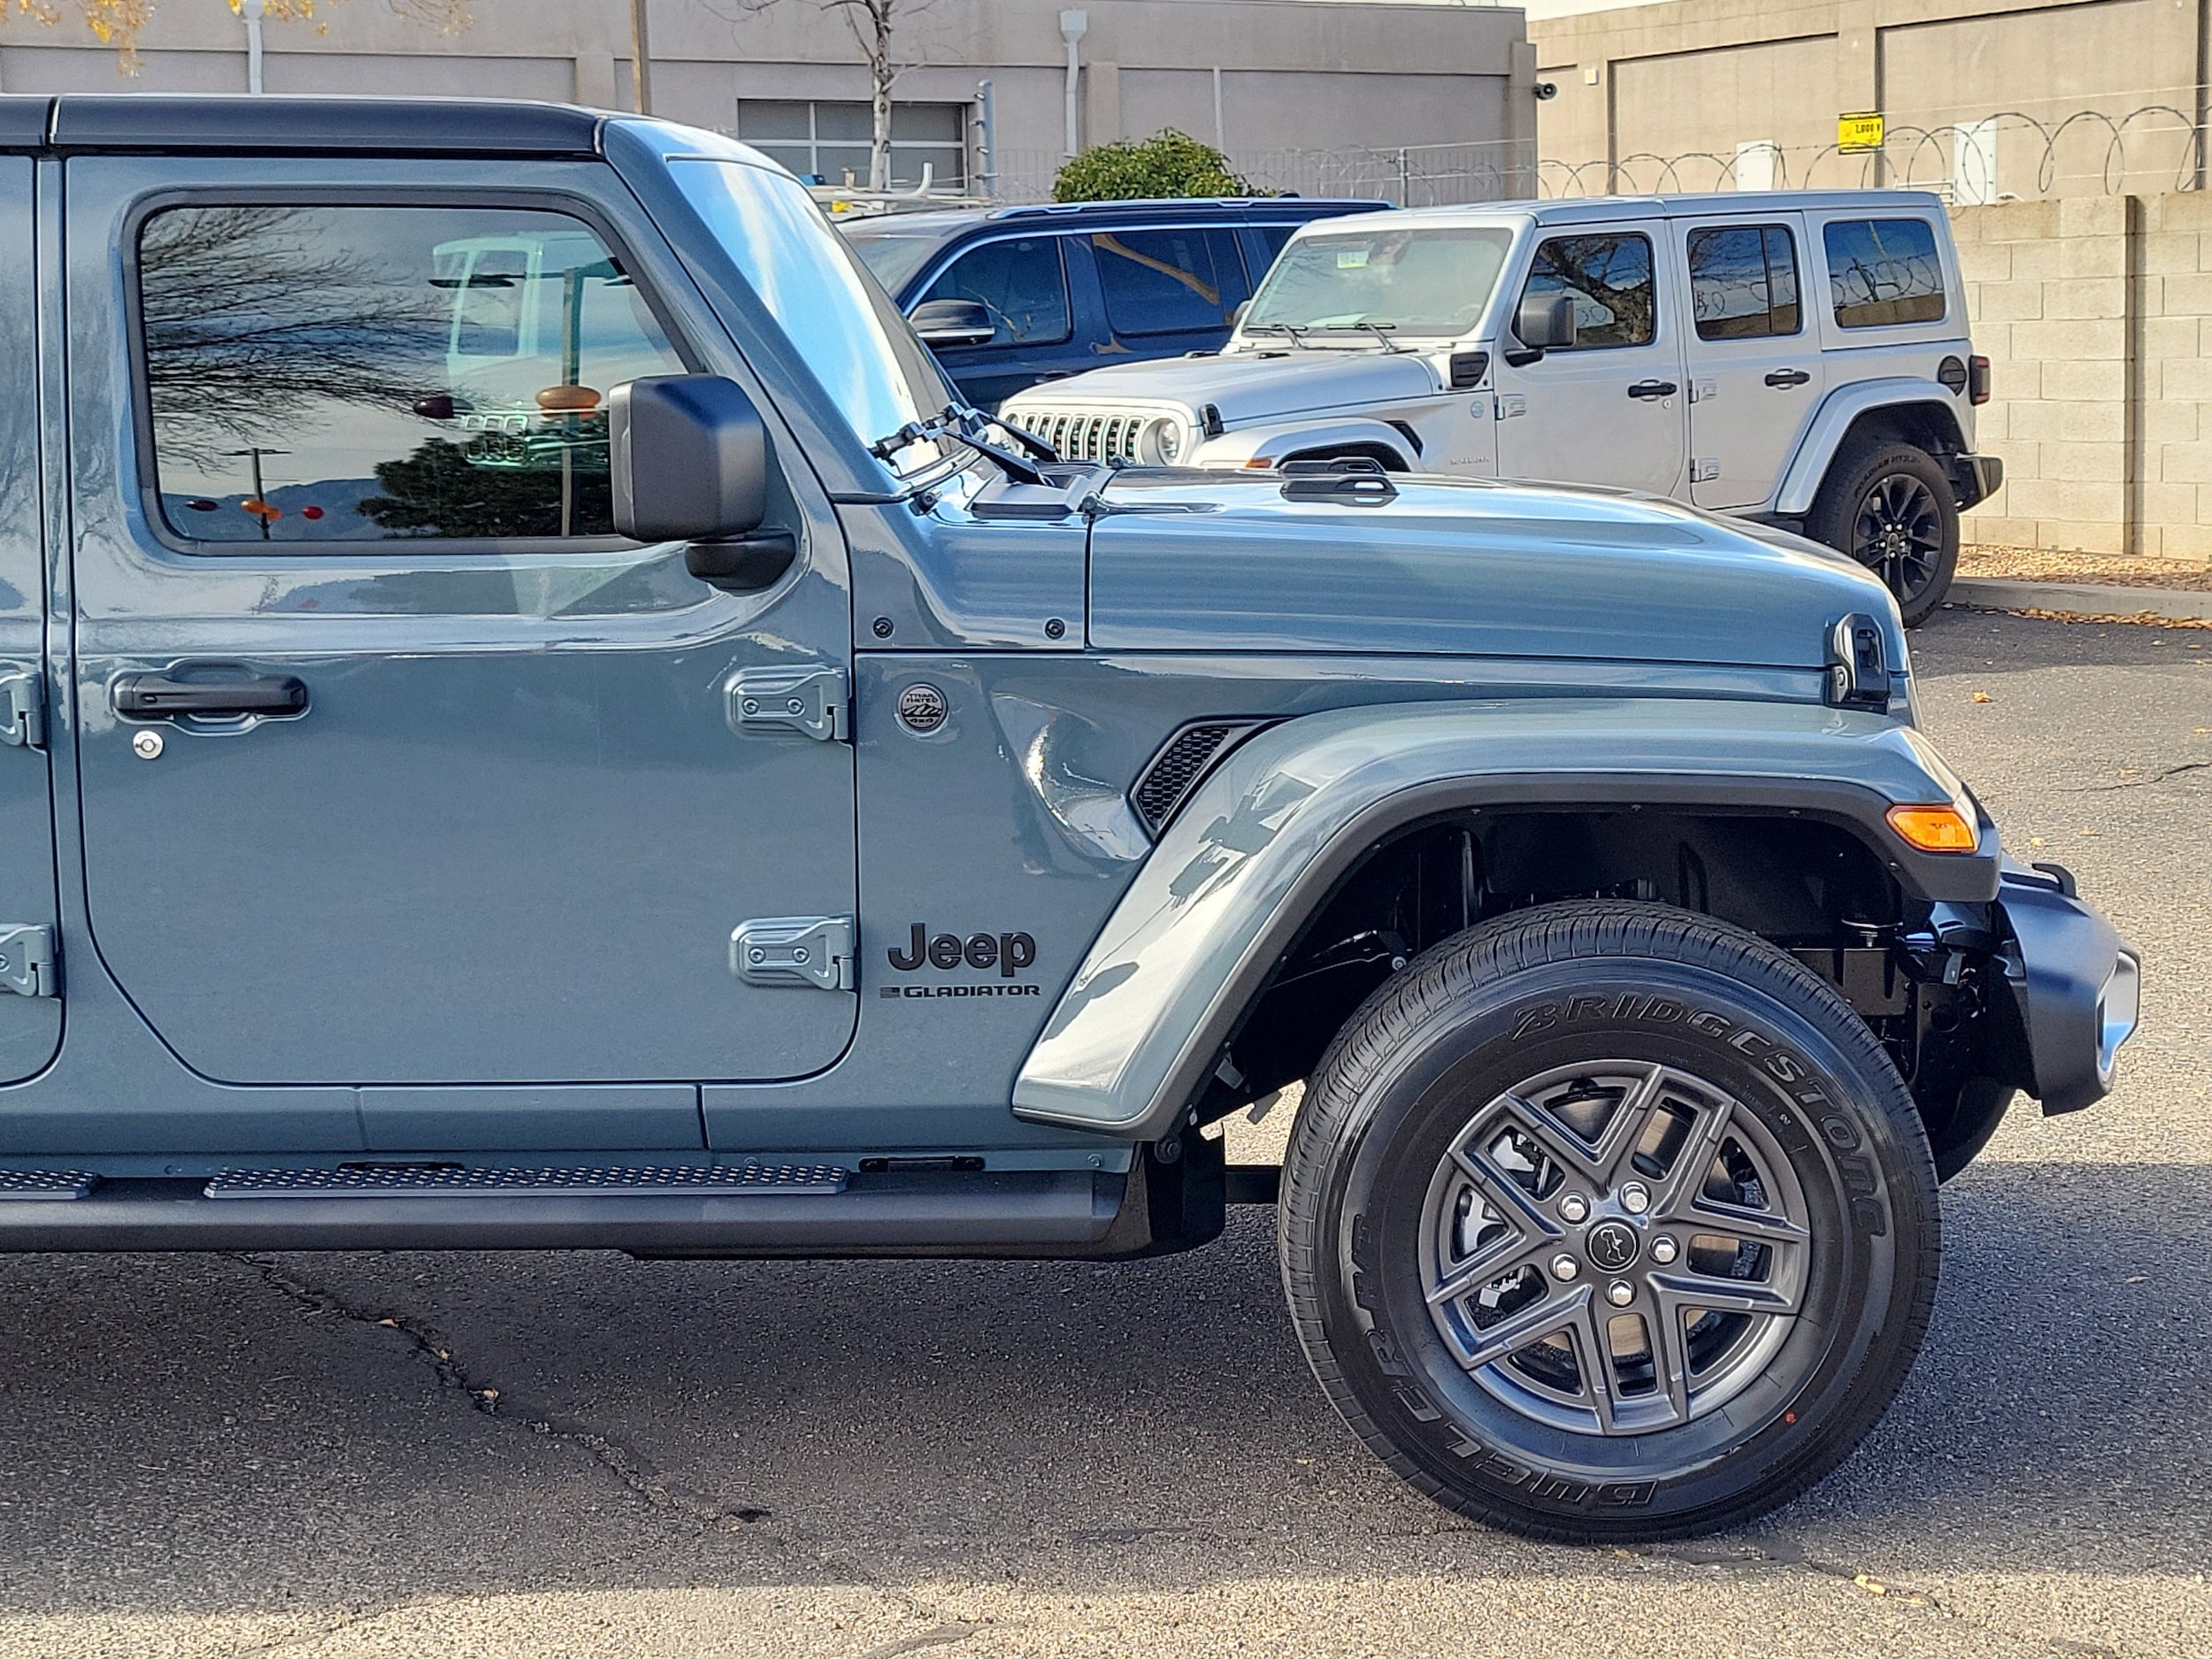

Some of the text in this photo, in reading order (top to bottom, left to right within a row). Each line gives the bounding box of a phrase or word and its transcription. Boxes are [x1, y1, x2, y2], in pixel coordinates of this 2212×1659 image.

[887, 922, 1036, 978] Jeep
[903, 985, 1041, 998] GLADIATOR
[1511, 991, 1886, 1237] BRIDGESTONE
[1364, 1327, 1660, 1505] DUELER
